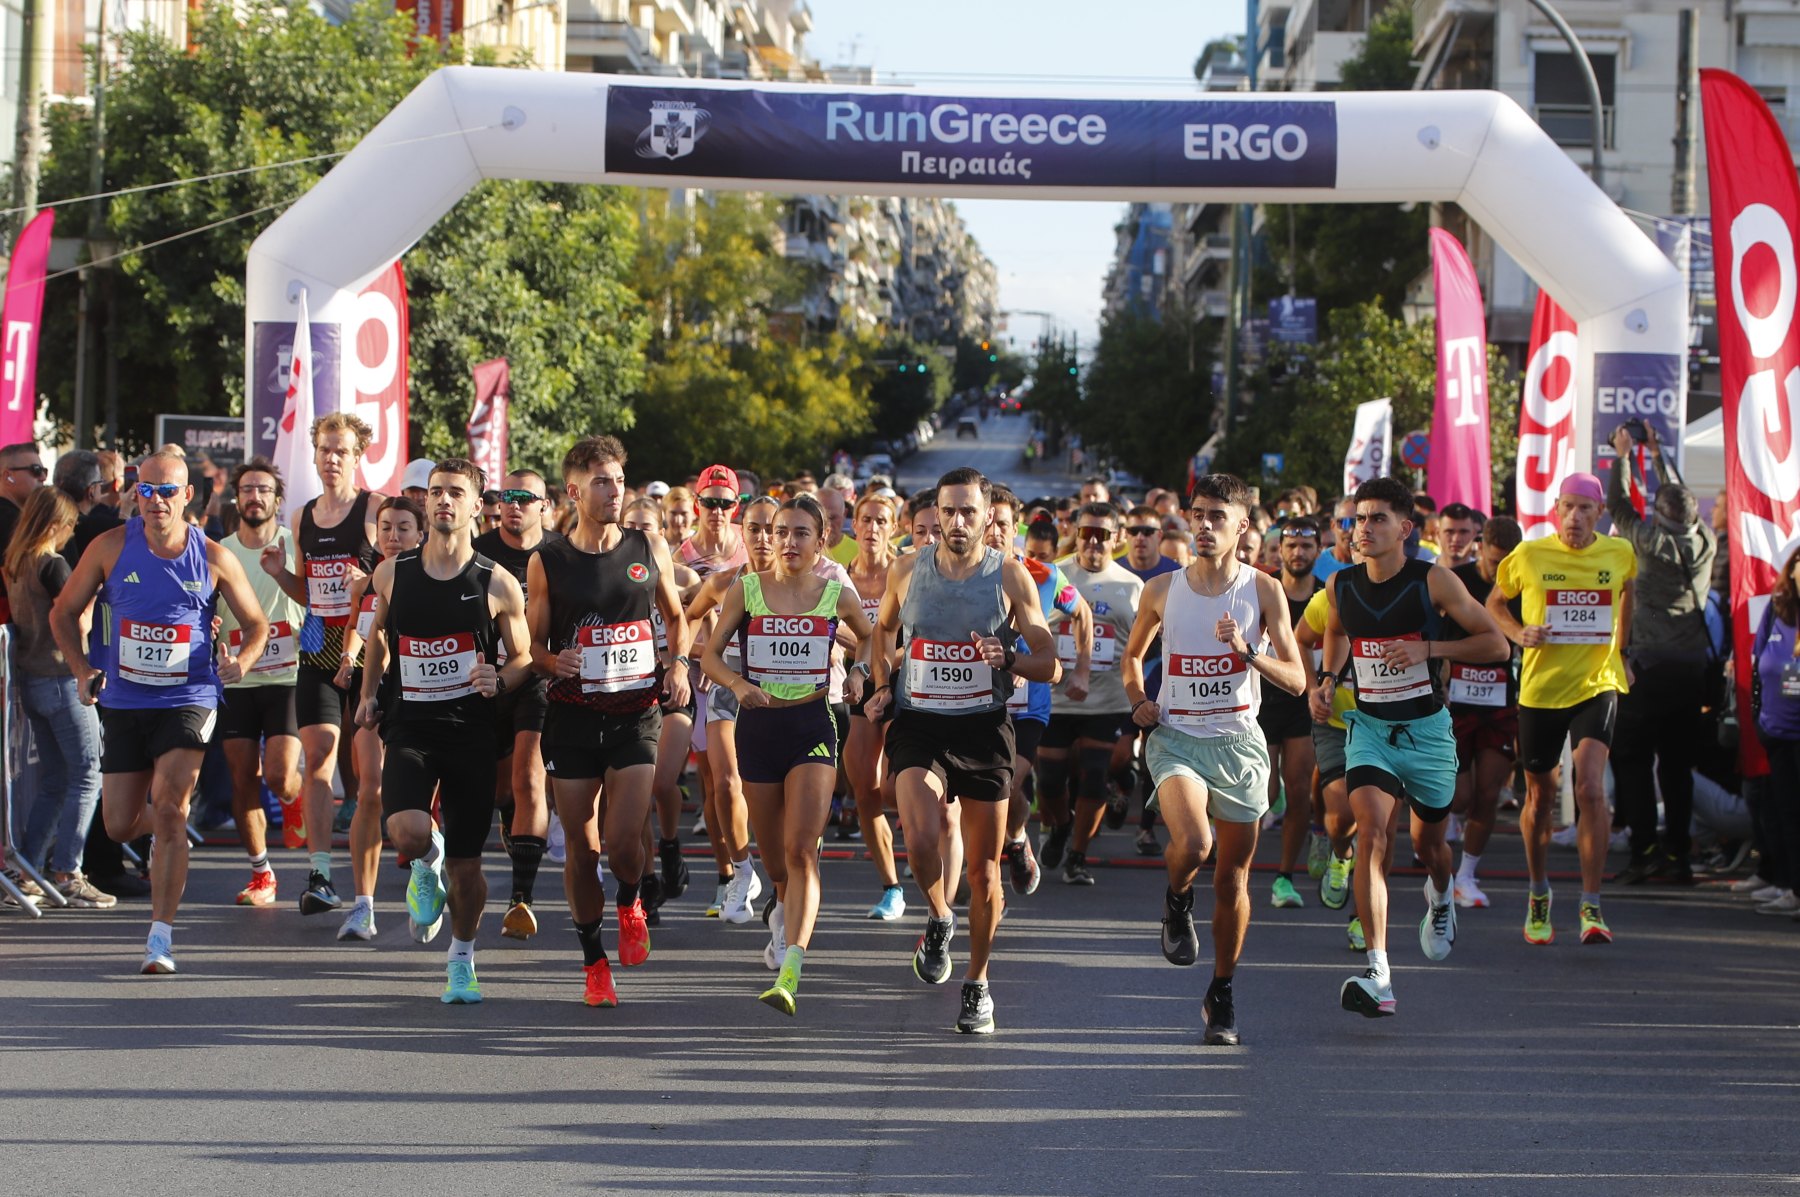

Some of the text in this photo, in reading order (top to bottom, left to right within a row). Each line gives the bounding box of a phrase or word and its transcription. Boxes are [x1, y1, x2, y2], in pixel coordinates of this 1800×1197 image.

[826, 101, 1107, 145] RunGreece
[1184, 123, 1308, 161] ERGO
[901, 150, 1032, 179] Πειραιάς
[1597, 386, 1677, 415] ERGO
[311, 562, 346, 577] ERGO
[1542, 573, 1566, 582] ERGO
[318, 582, 346, 595] 1244
[1557, 591, 1600, 605] ERGO
[1563, 609, 1596, 622] 1284
[130, 623, 178, 642] ERGO
[591, 624, 640, 645] ERGO
[762, 618, 814, 635] ERGO
[136, 645, 173, 662] 1217
[409, 637, 459, 656] ERGO
[769, 641, 811, 657] 1004
[923, 642, 976, 662] ERGO
[601, 648, 638, 666] 1182
[418, 660, 459, 677] 1269
[930, 666, 973, 682] 1590
[1181, 657, 1233, 675] ERGO
[1461, 667, 1497, 682] ERGO
[1189, 681, 1231, 698] 1045
[1466, 685, 1494, 697] 1337
